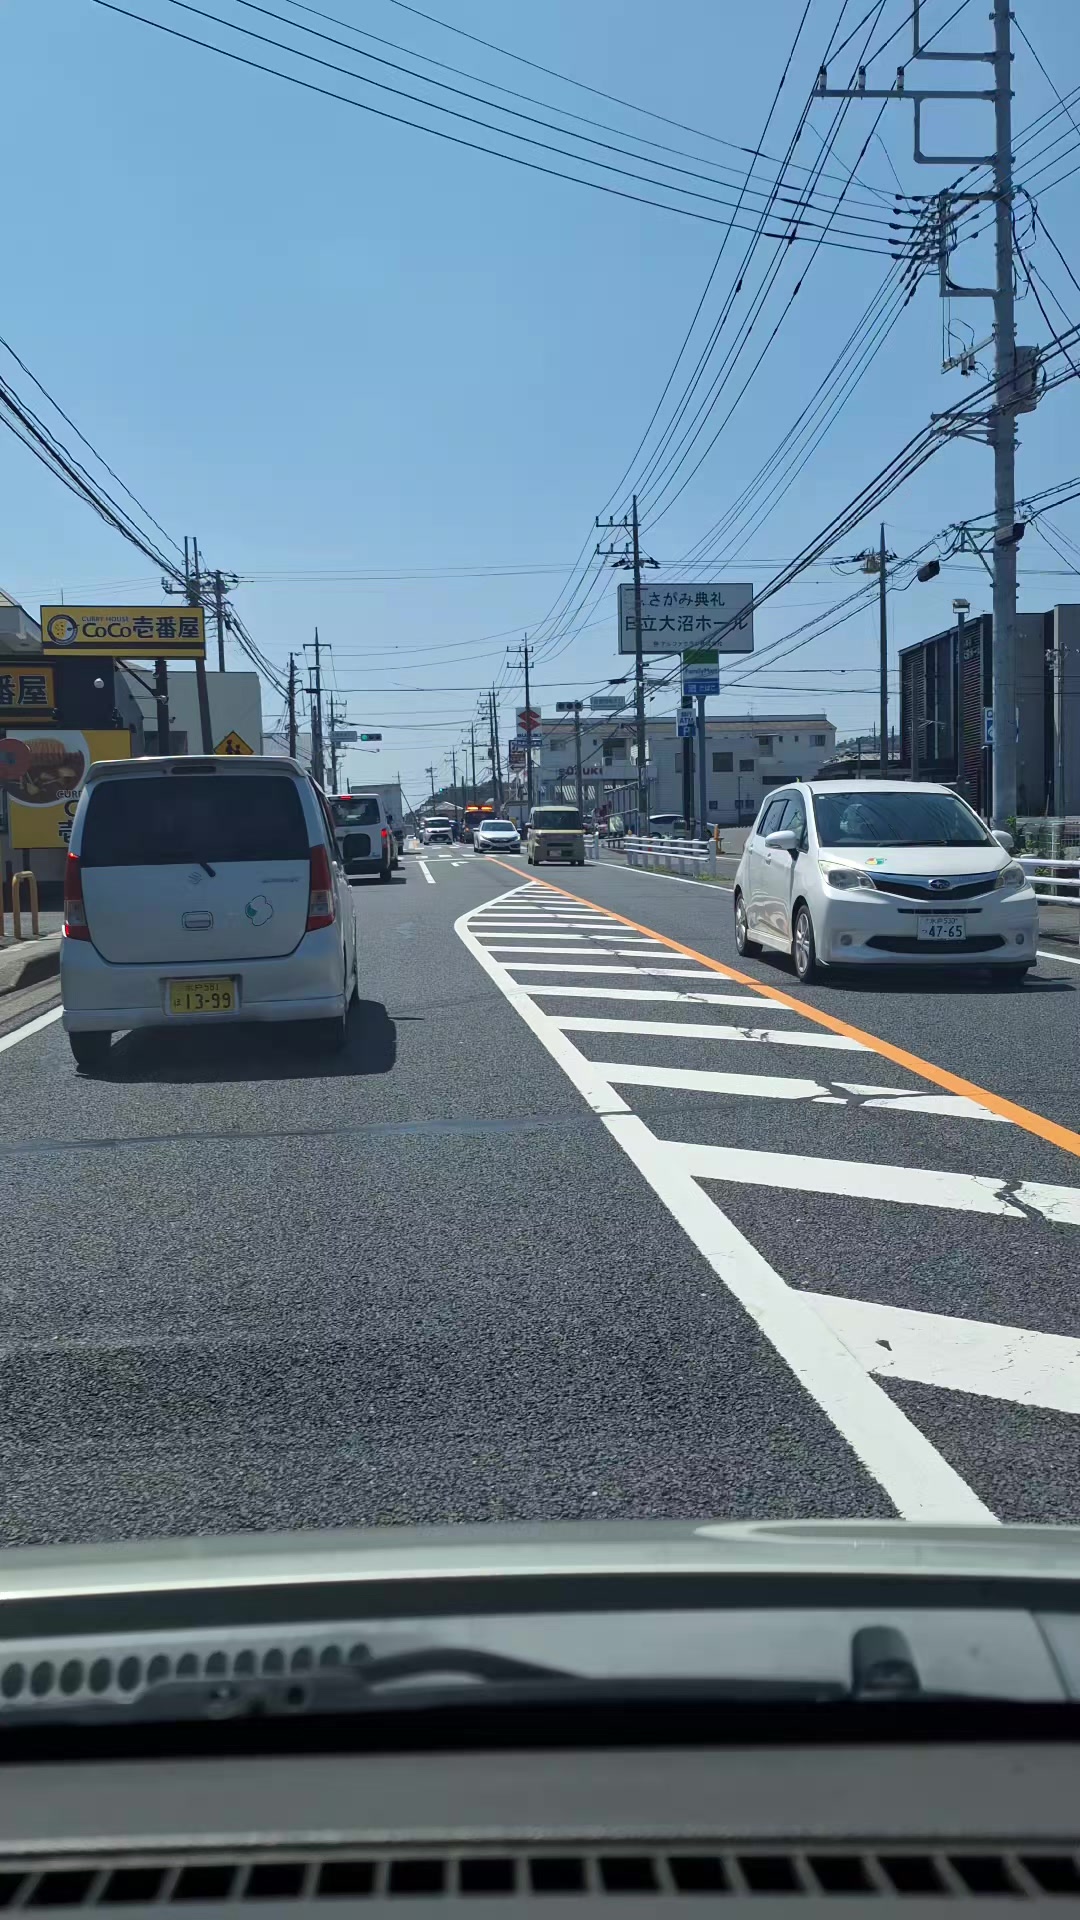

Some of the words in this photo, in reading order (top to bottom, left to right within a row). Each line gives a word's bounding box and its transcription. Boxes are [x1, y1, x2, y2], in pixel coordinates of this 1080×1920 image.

[649, 591, 726, 607] さがみ典礼
[81, 615, 103, 623] CURRY
[105, 615, 130, 623] HOUSE
[82, 615, 200, 639] CoCo壱番屋
[625, 614, 749, 632] 日立大沼ホール
[928, 925, 963, 937] 47-65
[186, 992, 231, 1010] 13-99
